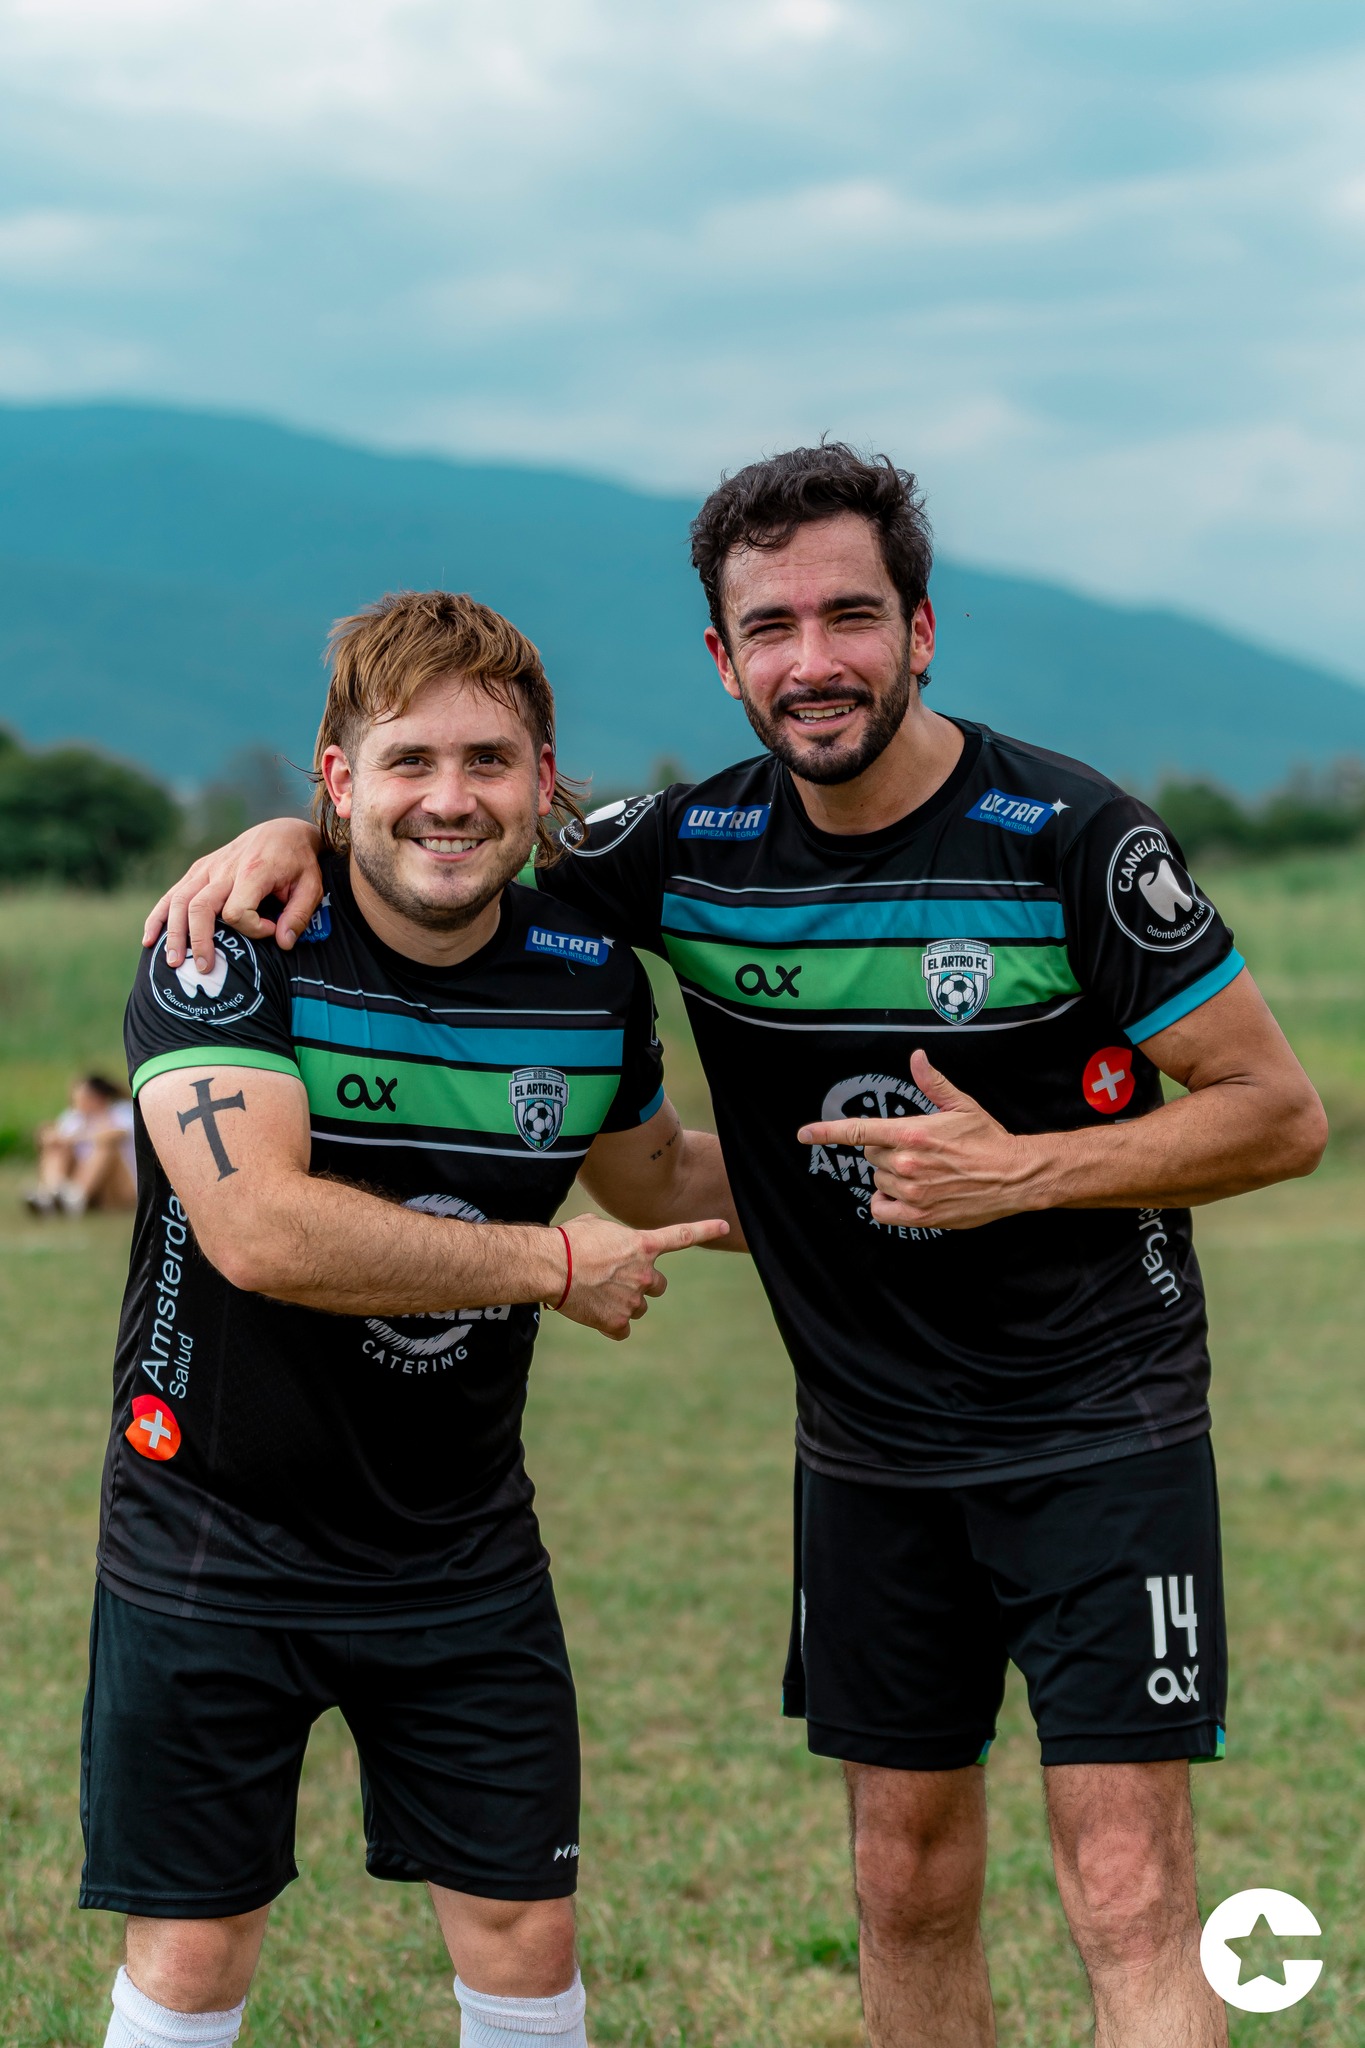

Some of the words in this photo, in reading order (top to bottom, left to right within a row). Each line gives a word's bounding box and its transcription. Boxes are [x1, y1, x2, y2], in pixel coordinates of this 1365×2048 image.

[687, 809, 763, 829] ULTRA
[980, 793, 1045, 825] ULTRA
[691, 829, 725, 838] LIMPIEZA
[726, 829, 760, 839] INTEGRAL
[1005, 821, 1033, 834] INTEGRAL
[1117, 838, 1170, 893] CANELAD
[531, 930, 600, 957] ULTRA
[536, 945, 568, 956] LIMPIEZA
[568, 950, 600, 965] INTEGRAL
[928, 957, 939, 971] EL
[940, 955, 974, 969] ARTRO
[975, 957, 988, 970] FC
[515, 1085, 525, 1097] EL
[526, 1083, 554, 1096] ARTRO
[554, 1085, 564, 1098] FC
[856, 1206, 953, 1241] CATERIN
[141, 1185, 189, 1392] Amsterda
[169, 1332, 194, 1399] Salud
[362, 1339, 468, 1375] CATERING
[1145, 1574, 1198, 1660] 14
